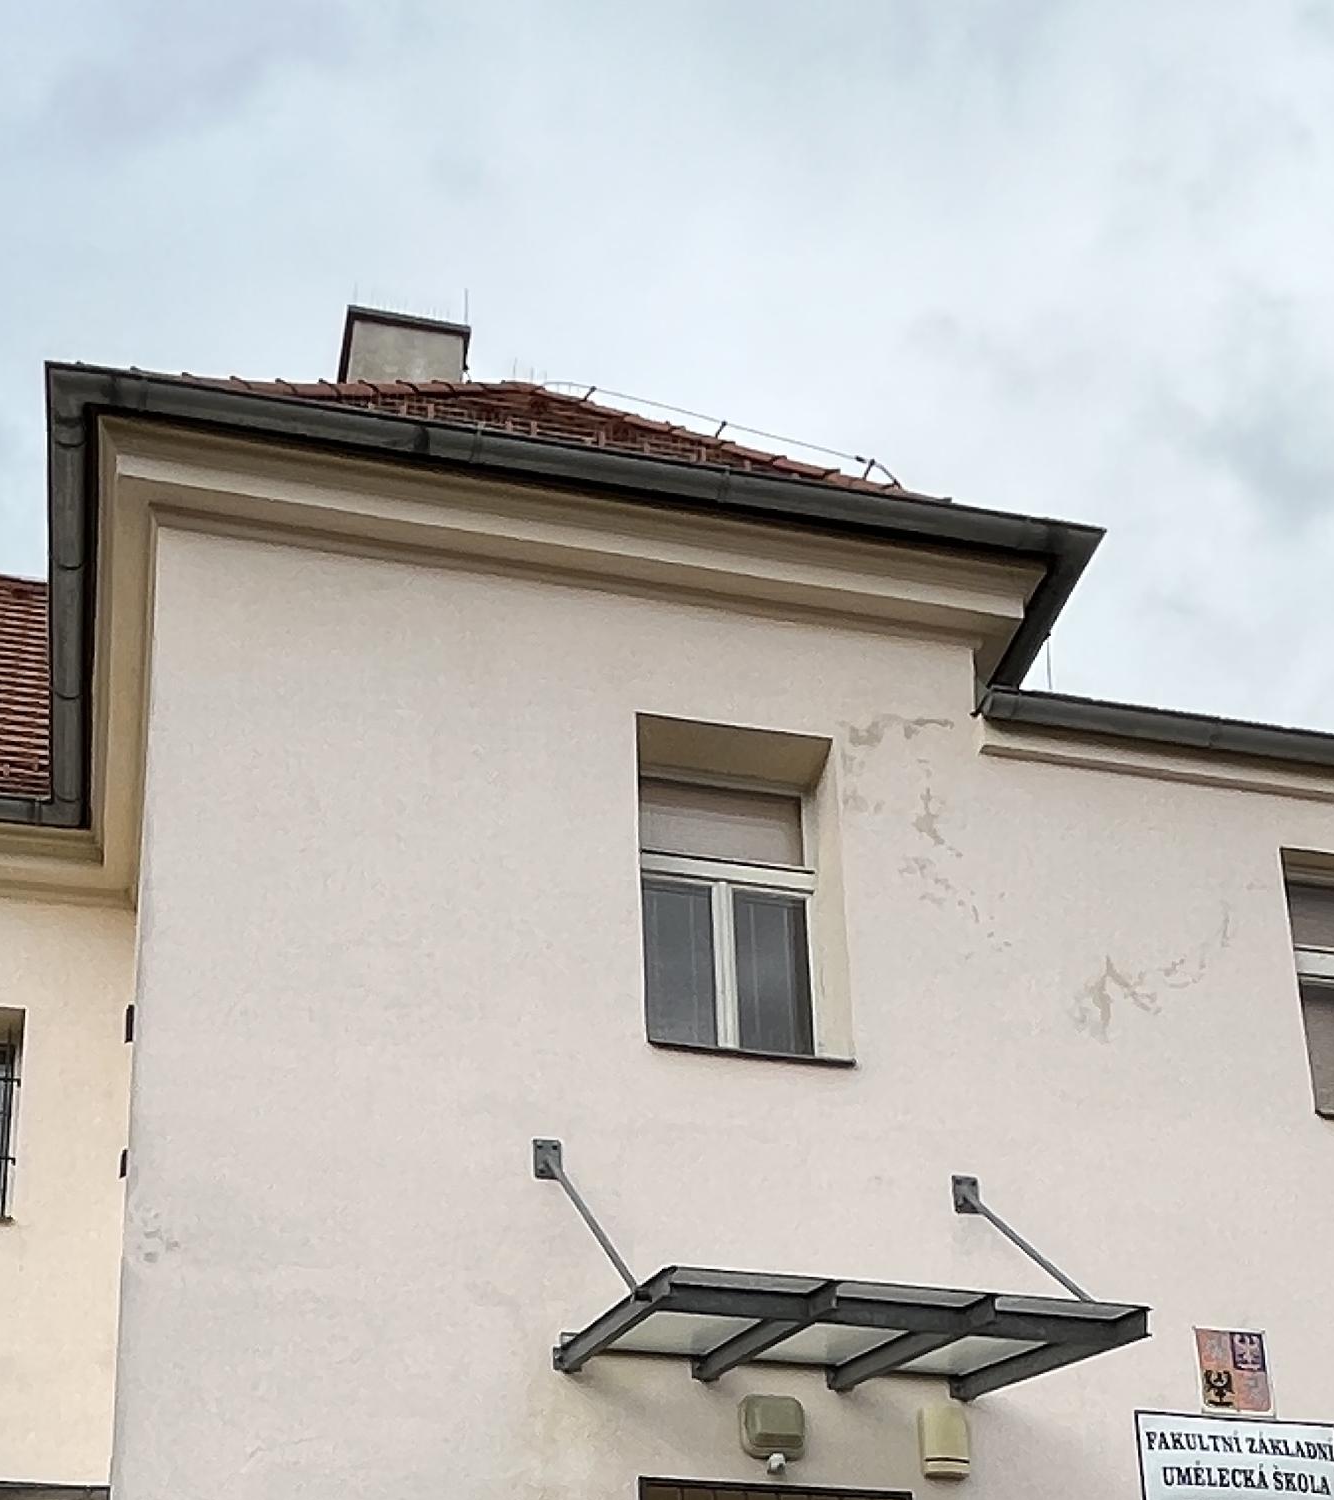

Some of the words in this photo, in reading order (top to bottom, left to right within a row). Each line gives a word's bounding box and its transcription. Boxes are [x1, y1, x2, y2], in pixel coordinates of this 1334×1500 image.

[1146, 1430, 1243, 1454] FAKULTNÍ
[1245, 1431, 1334, 1462] ZÁKLADNÍ
[1162, 1460, 1269, 1489] UMĚLECKÁ
[1273, 1464, 1331, 1495] ŠKOLA
